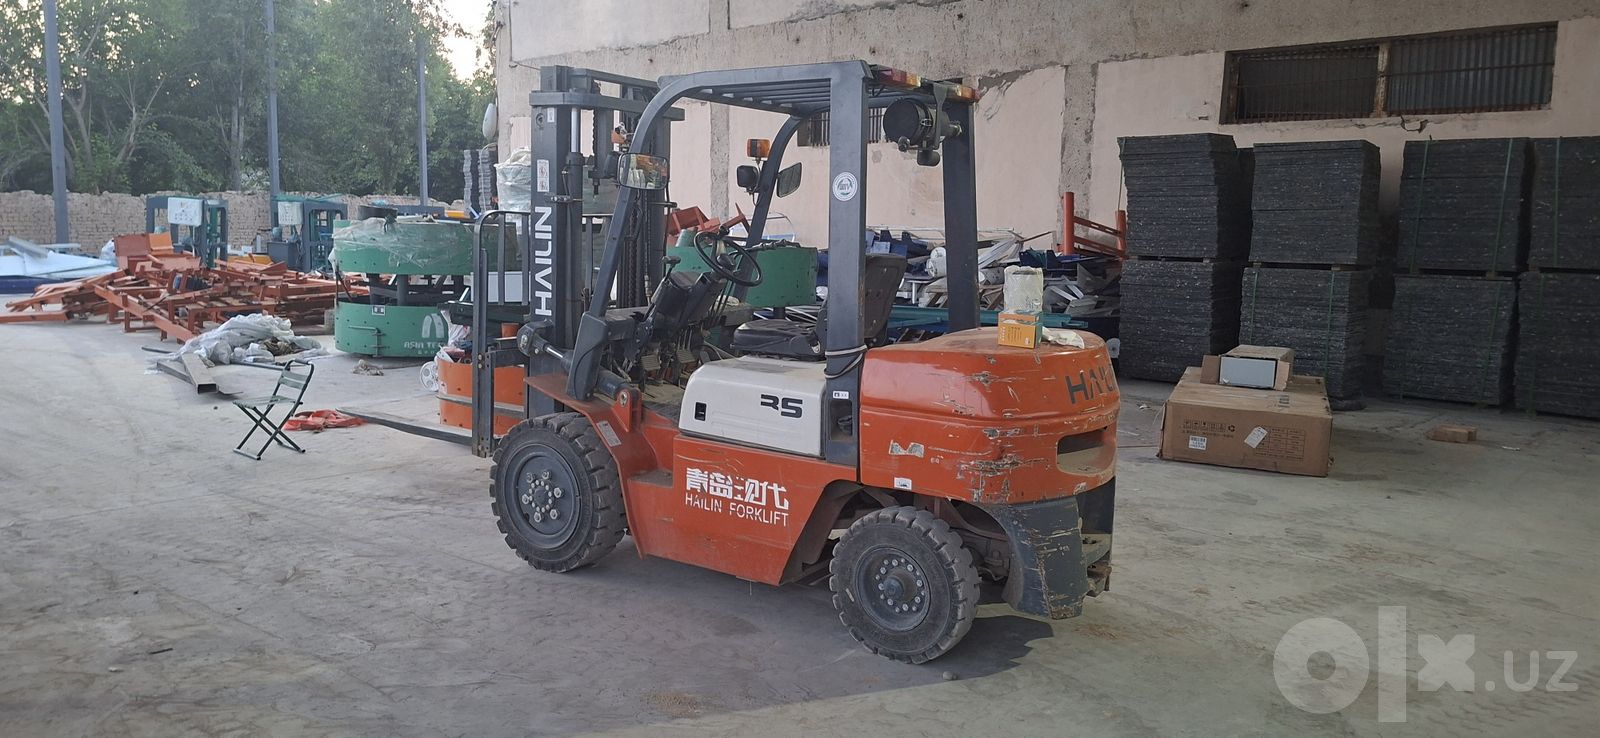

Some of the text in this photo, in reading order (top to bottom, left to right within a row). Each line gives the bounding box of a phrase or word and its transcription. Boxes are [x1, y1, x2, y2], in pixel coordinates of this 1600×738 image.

[535, 206, 552, 316] HAILIN
[685, 492, 790, 527] HAILIN FORKLIFT
